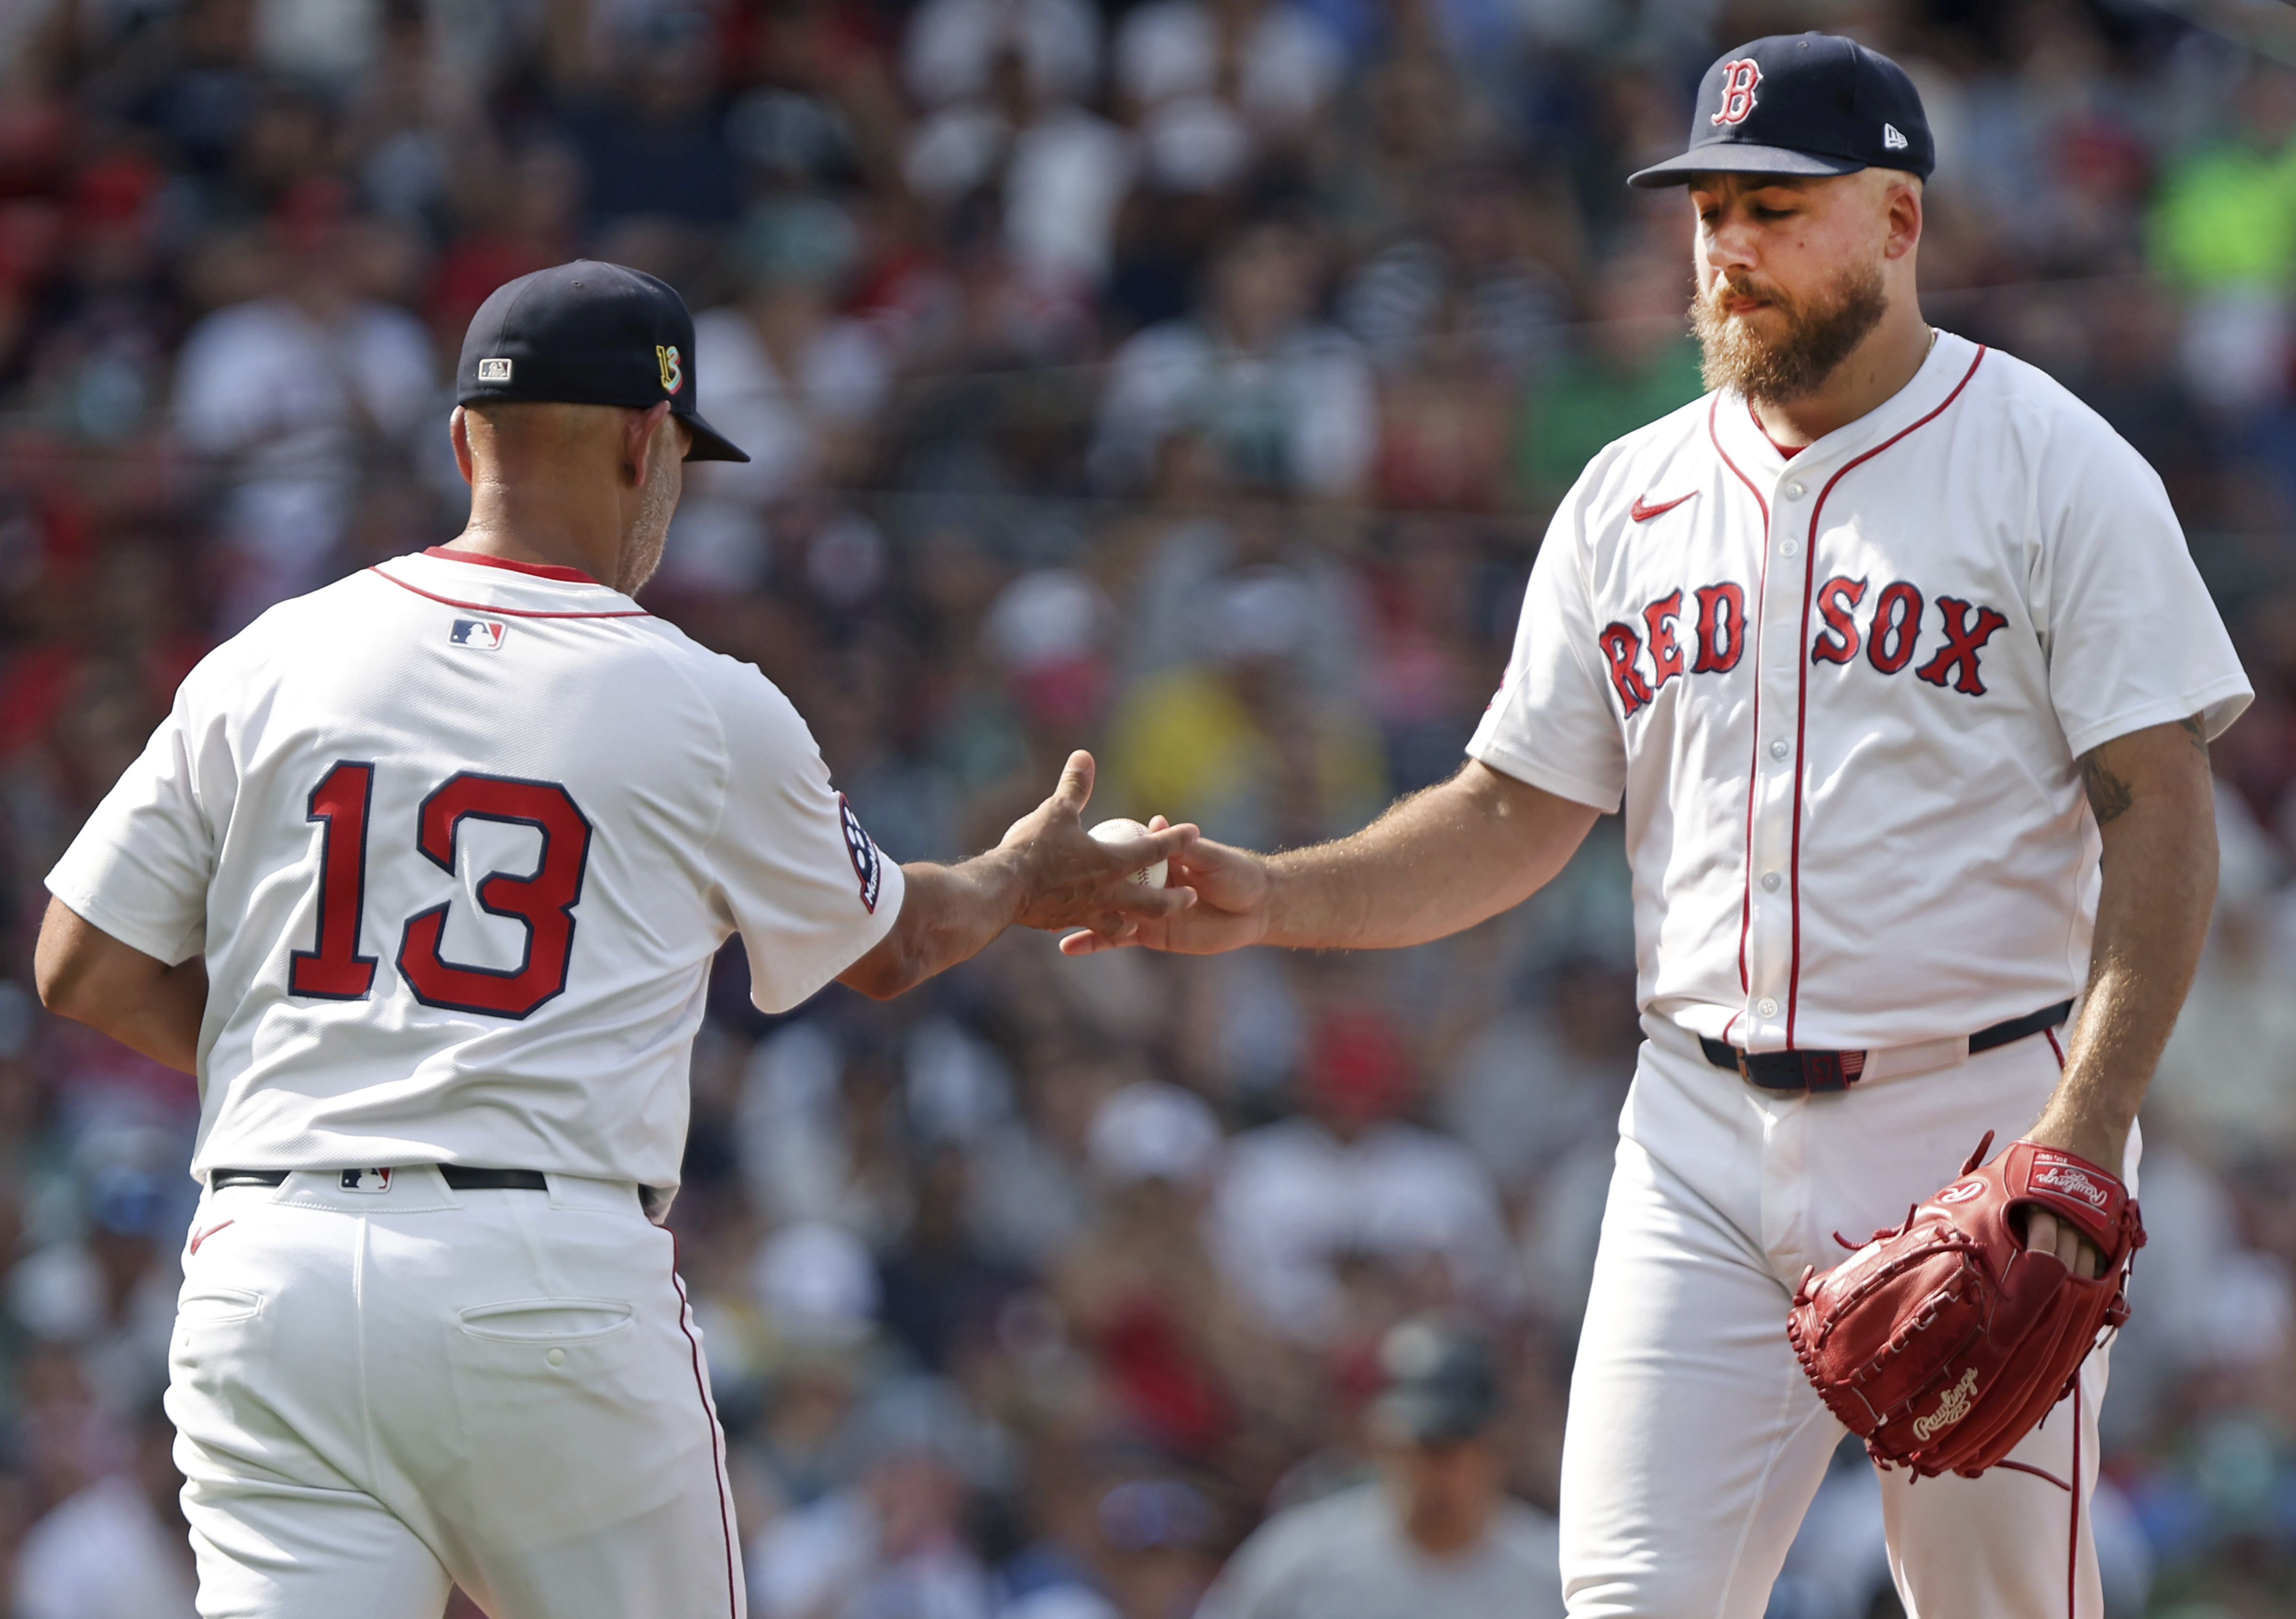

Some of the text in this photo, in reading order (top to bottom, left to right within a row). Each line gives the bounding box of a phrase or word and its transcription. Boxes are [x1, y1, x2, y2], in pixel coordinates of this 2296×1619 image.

[1711, 58, 1764, 126] B
[656, 345, 683, 395] 13
[1599, 575, 2009, 719] RED SOX
[288, 759, 592, 1021] 13
[1812, 1055, 1832, 1084] 57
[1942, 1182, 1982, 1202] R
[2036, 1167, 2108, 1206] Rawlings
[1913, 1367, 1978, 1441] Rawlings
